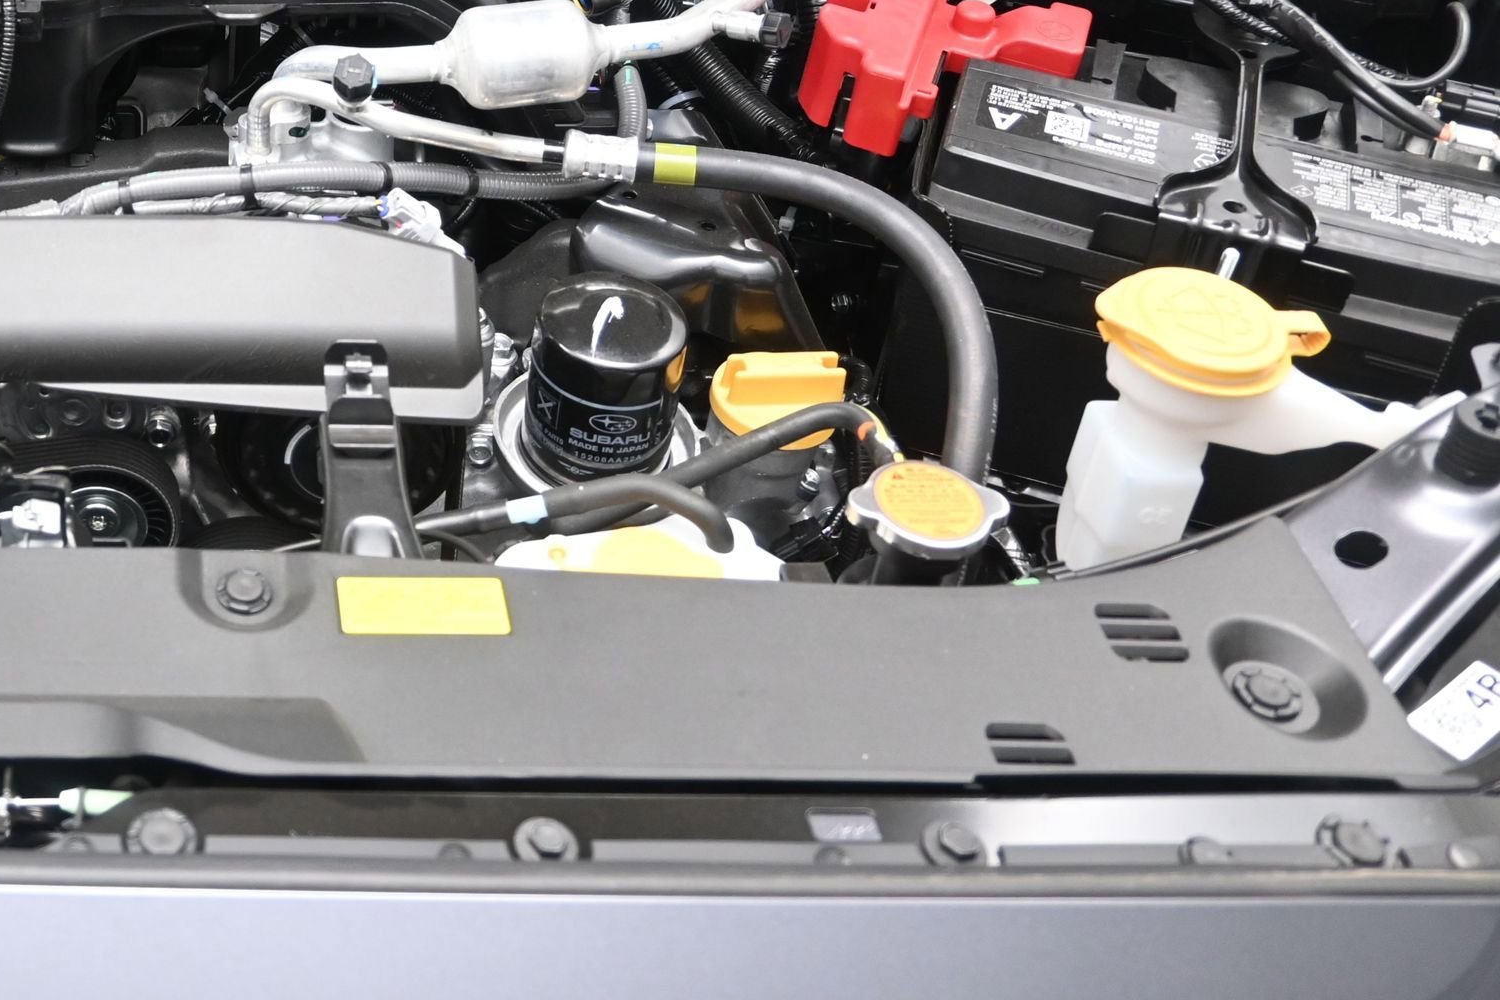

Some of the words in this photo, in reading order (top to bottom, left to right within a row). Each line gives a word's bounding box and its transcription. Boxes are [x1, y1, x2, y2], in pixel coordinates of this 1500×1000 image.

[1052, 136, 1078, 146] AMPS
[1095, 139, 1131, 153] AMPS
[1124, 138, 1156, 149] GROUP
[1079, 142, 1127, 158] CRANKING
[1128, 154, 1155, 164] COLD
[569, 426, 651, 446] SUBARU
[568, 437, 598, 452] MADE
[601, 446, 613, 454] IN
[616, 442, 649, 454] JAPAN
